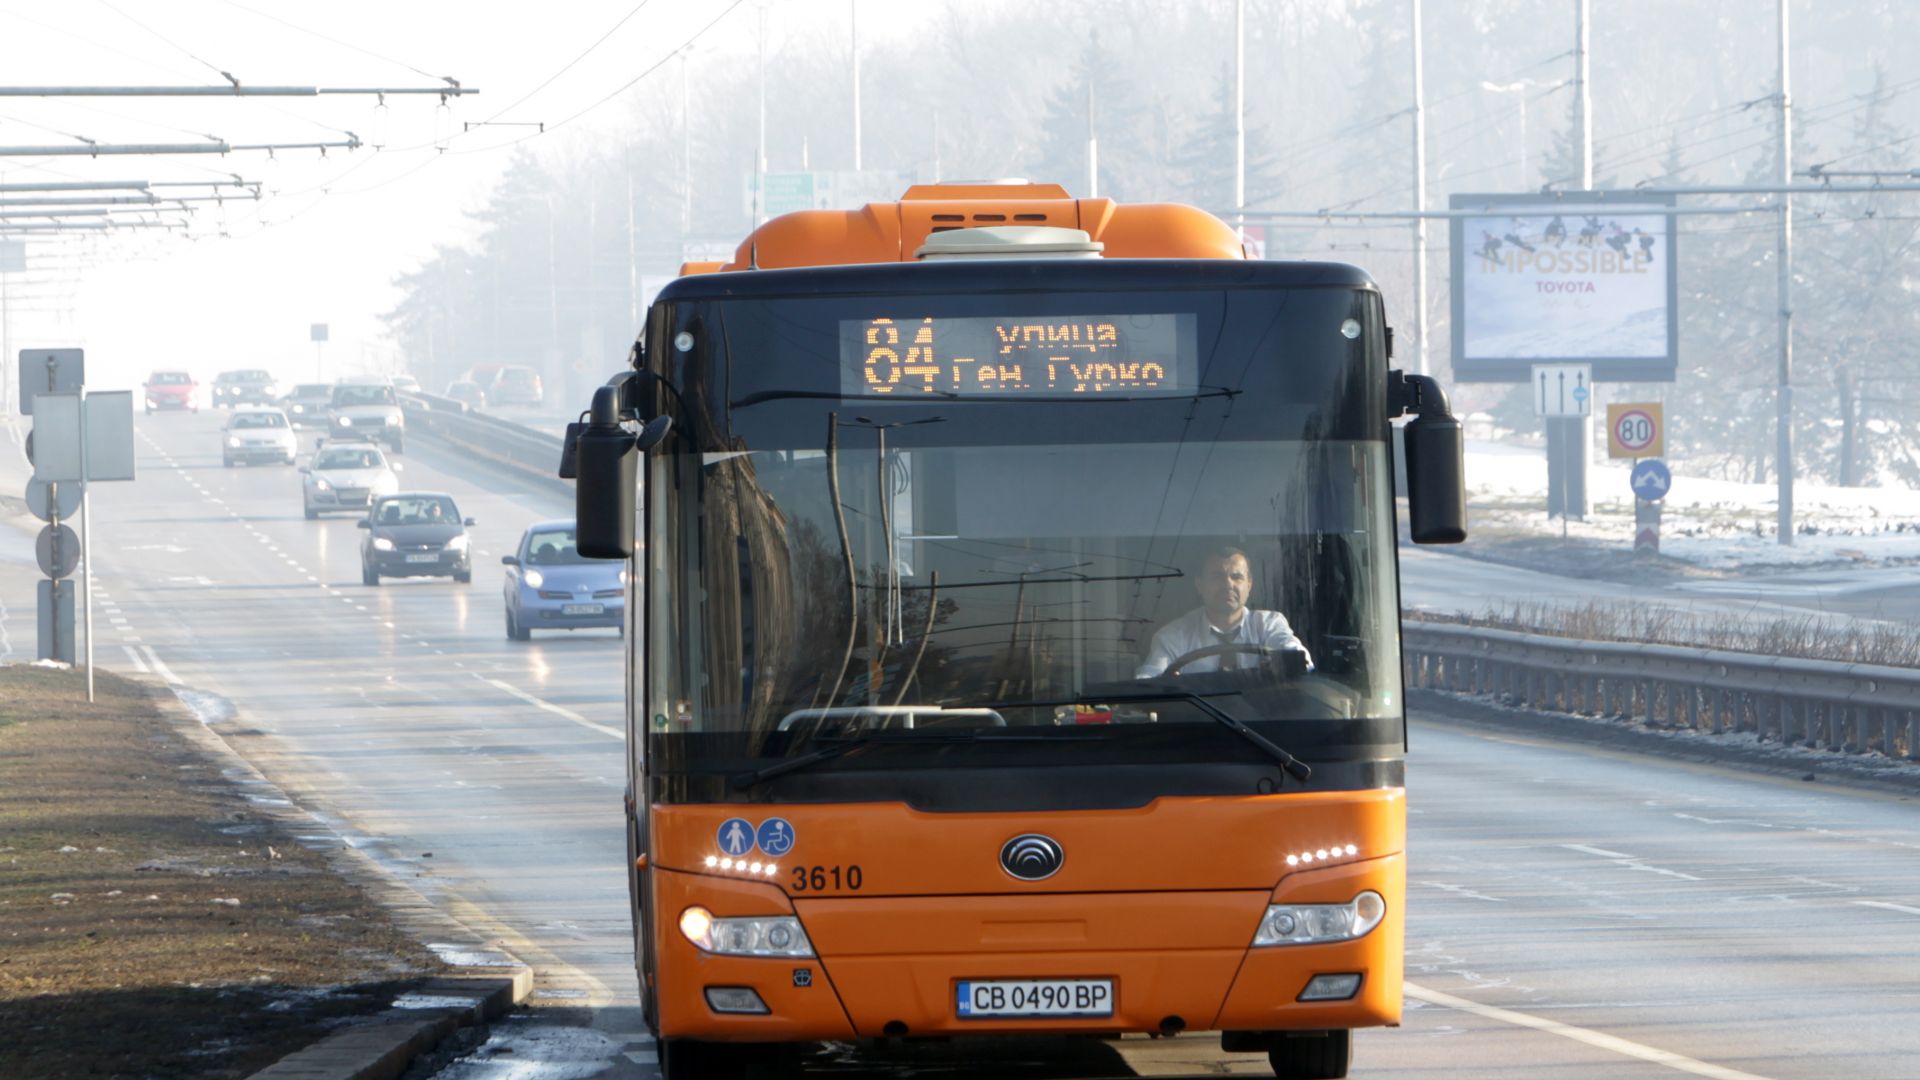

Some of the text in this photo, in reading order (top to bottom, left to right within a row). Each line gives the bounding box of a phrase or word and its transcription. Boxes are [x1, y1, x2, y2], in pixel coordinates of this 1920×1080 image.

[1481, 249, 1648, 274] IMPOSSIBLE
[1536, 281, 1596, 294] TOYOTA
[996, 323, 1118, 354] улица
[865, 317, 941, 393] 84
[1047, 357, 1164, 392] Гурко
[1621, 419, 1649, 442] 80
[791, 865, 863, 891] 3610
[974, 985, 1107, 1010] CB 0490 BP
